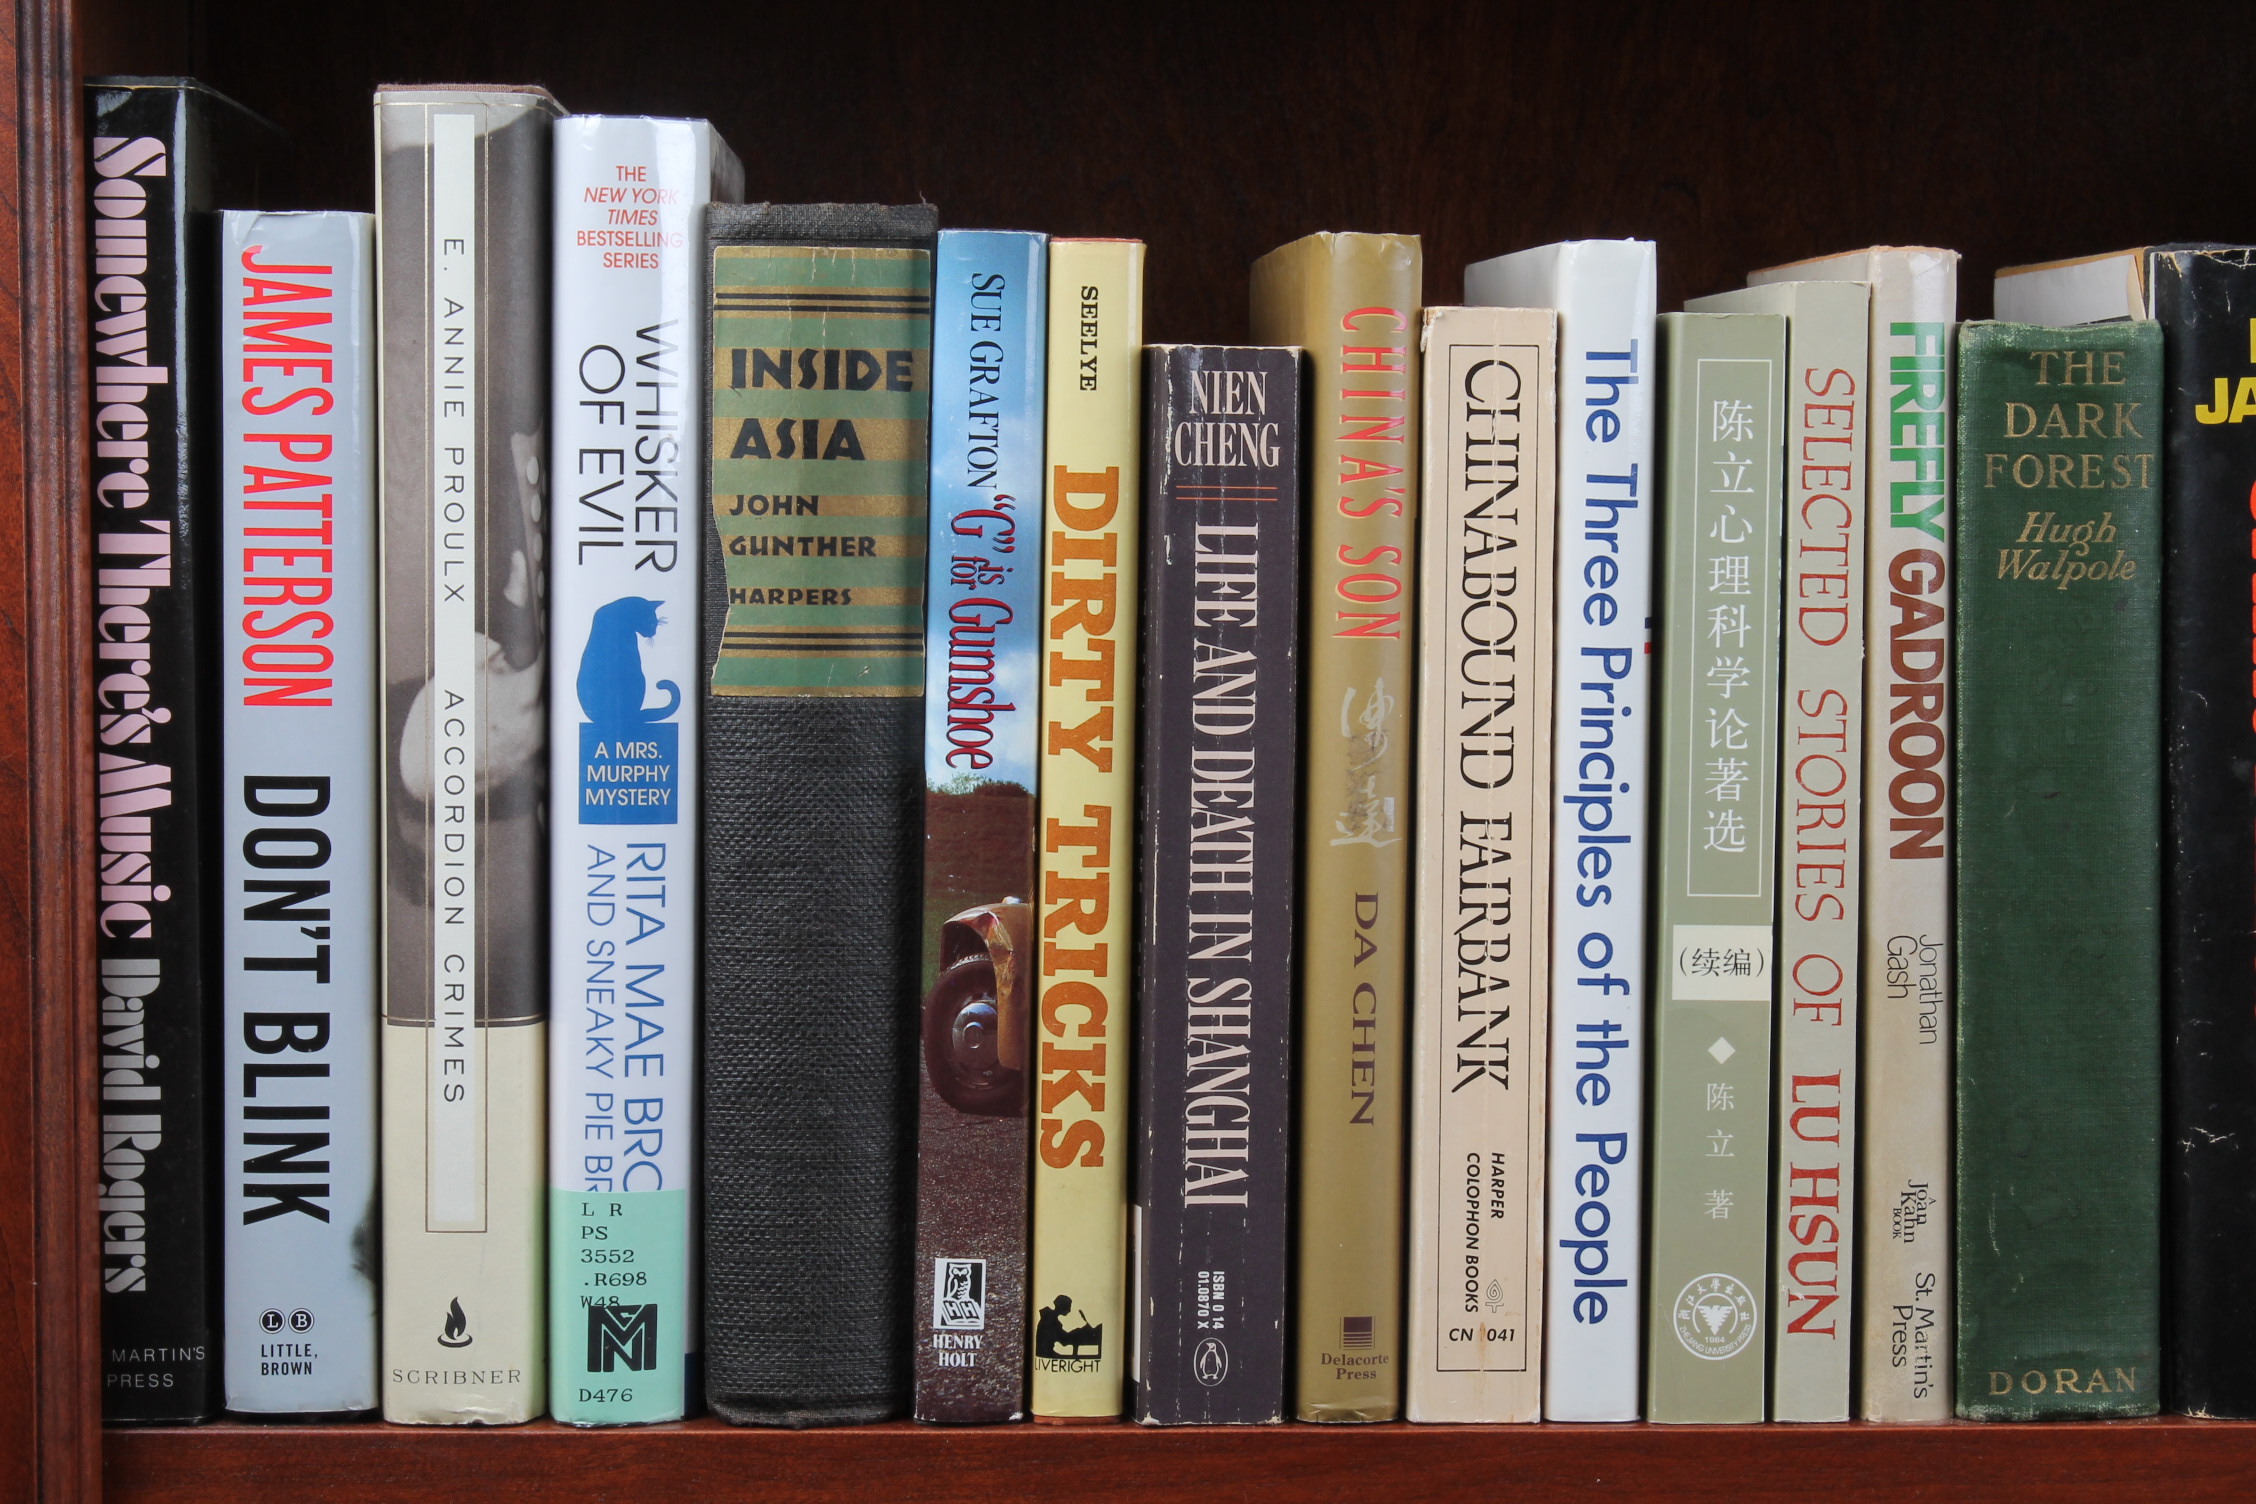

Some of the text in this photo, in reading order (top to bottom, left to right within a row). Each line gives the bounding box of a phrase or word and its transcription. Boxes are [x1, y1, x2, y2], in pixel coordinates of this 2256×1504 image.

[616, 165, 647, 182] THE
[584, 187, 679, 204] NEW YORK
[607, 208, 658, 226] TIMES
[576, 230, 684, 249] BESTSELLING
[602, 251, 660, 270] SERIES
[1079, 285, 1099, 391] SEELYE
[730, 349, 914, 392] INSIDE
[966, 272, 1006, 490] SUE GRAFTON
[2031, 350, 2126, 386] THE
[1189, 370, 1268, 416] NIEN
[1333, 306, 1408, 520] CHINA'S
[443, 237, 465, 603] E. ANNIE PROULX
[730, 417, 866, 461] ASIA
[2004, 402, 2143, 439] DARK
[578, 344, 626, 566] OF EVIL
[635, 319, 680, 573] WHISKER
[1174, 423, 1280, 468] CHENG
[241, 246, 334, 707] JAMES PATTERSON
[1984, 454, 2156, 489] FOREST
[729, 494, 819, 517] JOHN
[93, 136, 172, 938] Somewhere There's Music
[729, 535, 877, 558] GUNTHER
[2015, 511, 2117, 557] Hugh
[951, 556, 990, 591] for
[978, 565, 1014, 585] is
[1459, 359, 1522, 790] CHINABOUND
[1888, 321, 1946, 860] FIREFLY GADROON
[1997, 549, 2137, 590] Walpole
[729, 587, 853, 606] HARPERS
[1332, 543, 1403, 641] SON
[1704, 398, 1754, 854] 陈立心理科学论著选
[946, 597, 1017, 770] Gumshoe
[595, 742, 662, 759] A MRS.
[586, 765, 671, 783] MURPHY
[585, 788, 672, 806] MYSTERY
[1040, 465, 1119, 1170] DIRTY TRICKS
[1559, 339, 1639, 1326] The Three Principles of the People
[1787, 368, 1856, 1340] SELECTED STORIES OF LU HSUN
[586, 845, 616, 927] AND
[1184, 522, 1259, 1209] LIFE AND DEATH IN SHANGHAI
[443, 689, 465, 1104] ACCORDION CRIMES
[626, 843, 666, 946] RITA
[1451, 811, 1512, 1093] FAIRBANK
[1886, 935, 1918, 1000] Gash
[243, 776, 331, 1225] DON'T BLINK
[585, 940, 615, 1079] SNEAKY
[1349, 891, 1379, 1126] DA CHEN
[1918, 934, 1944, 1046] Jonathan
[625, 964, 665, 1078] MAE
[99, 958, 162, 1294] David Rogers
[584, 1093, 614, 1142] PIE
[1491, 1152, 1505, 1219] HARPER
[1908, 1179, 1929, 1225] Joan
[581, 1203, 623, 1217] L R
[1893, 1208, 1902, 1239] BOOK
[1901, 1191, 1918, 1244] Kahn
[581, 1226, 608, 1241] PS
[1465, 1153, 1481, 1313] COLOPHON BOOKS
[580, 1249, 635, 1263] 3552
[584, 1272, 647, 1287] .R698
[1212, 1271, 1225, 1300] ISBN
[933, 1334, 983, 1350] HENRY
[1197, 1321, 1210, 1329] X
[1212, 1316, 1225, 1330] 14
[1449, 1328, 1473, 1342] CN
[1704, 1336, 1726, 1344] 1984
[1892, 1305, 1914, 1368] Press
[1914, 1272, 1936, 1399] St. Martin's
[112, 1346, 205, 1362] MARTIN'S
[261, 1344, 318, 1359] LITTLE,
[261, 1362, 313, 1376] BROWN
[939, 1352, 978, 1367] HOLT
[1035, 1359, 1102, 1373] LIVERIGHT
[1320, 1352, 1390, 1367] Delacorte
[107, 1374, 174, 1388] PRESS
[392, 1368, 521, 1386] SCRIBNER
[579, 1388, 633, 1403] D476
[1335, 1367, 1378, 1382] Press
[1989, 1367, 2136, 1396] DORAN
